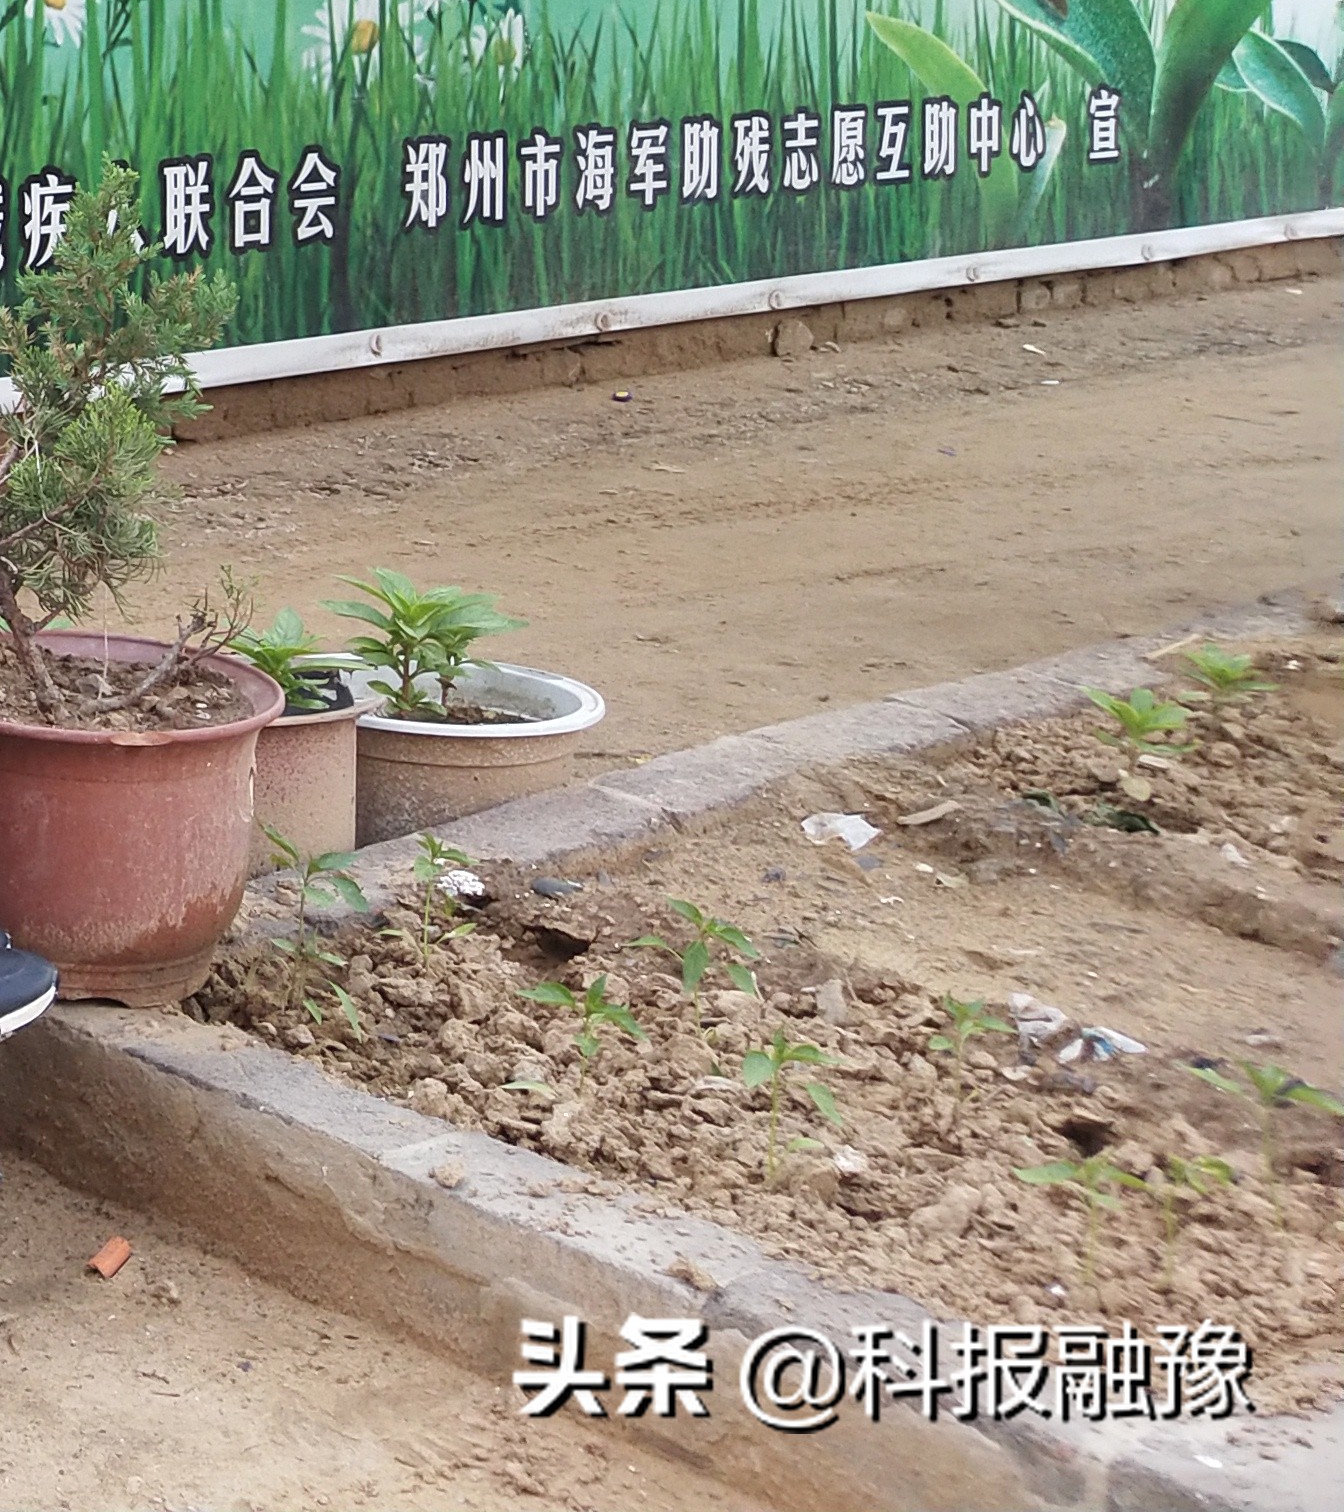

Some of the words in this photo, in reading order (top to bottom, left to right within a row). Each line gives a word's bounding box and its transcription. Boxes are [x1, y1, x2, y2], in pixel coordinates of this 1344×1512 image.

[403, 90, 1047, 228] 郑州市海军助残志愿互助中心
[1088, 87, 1121, 161] 宣
